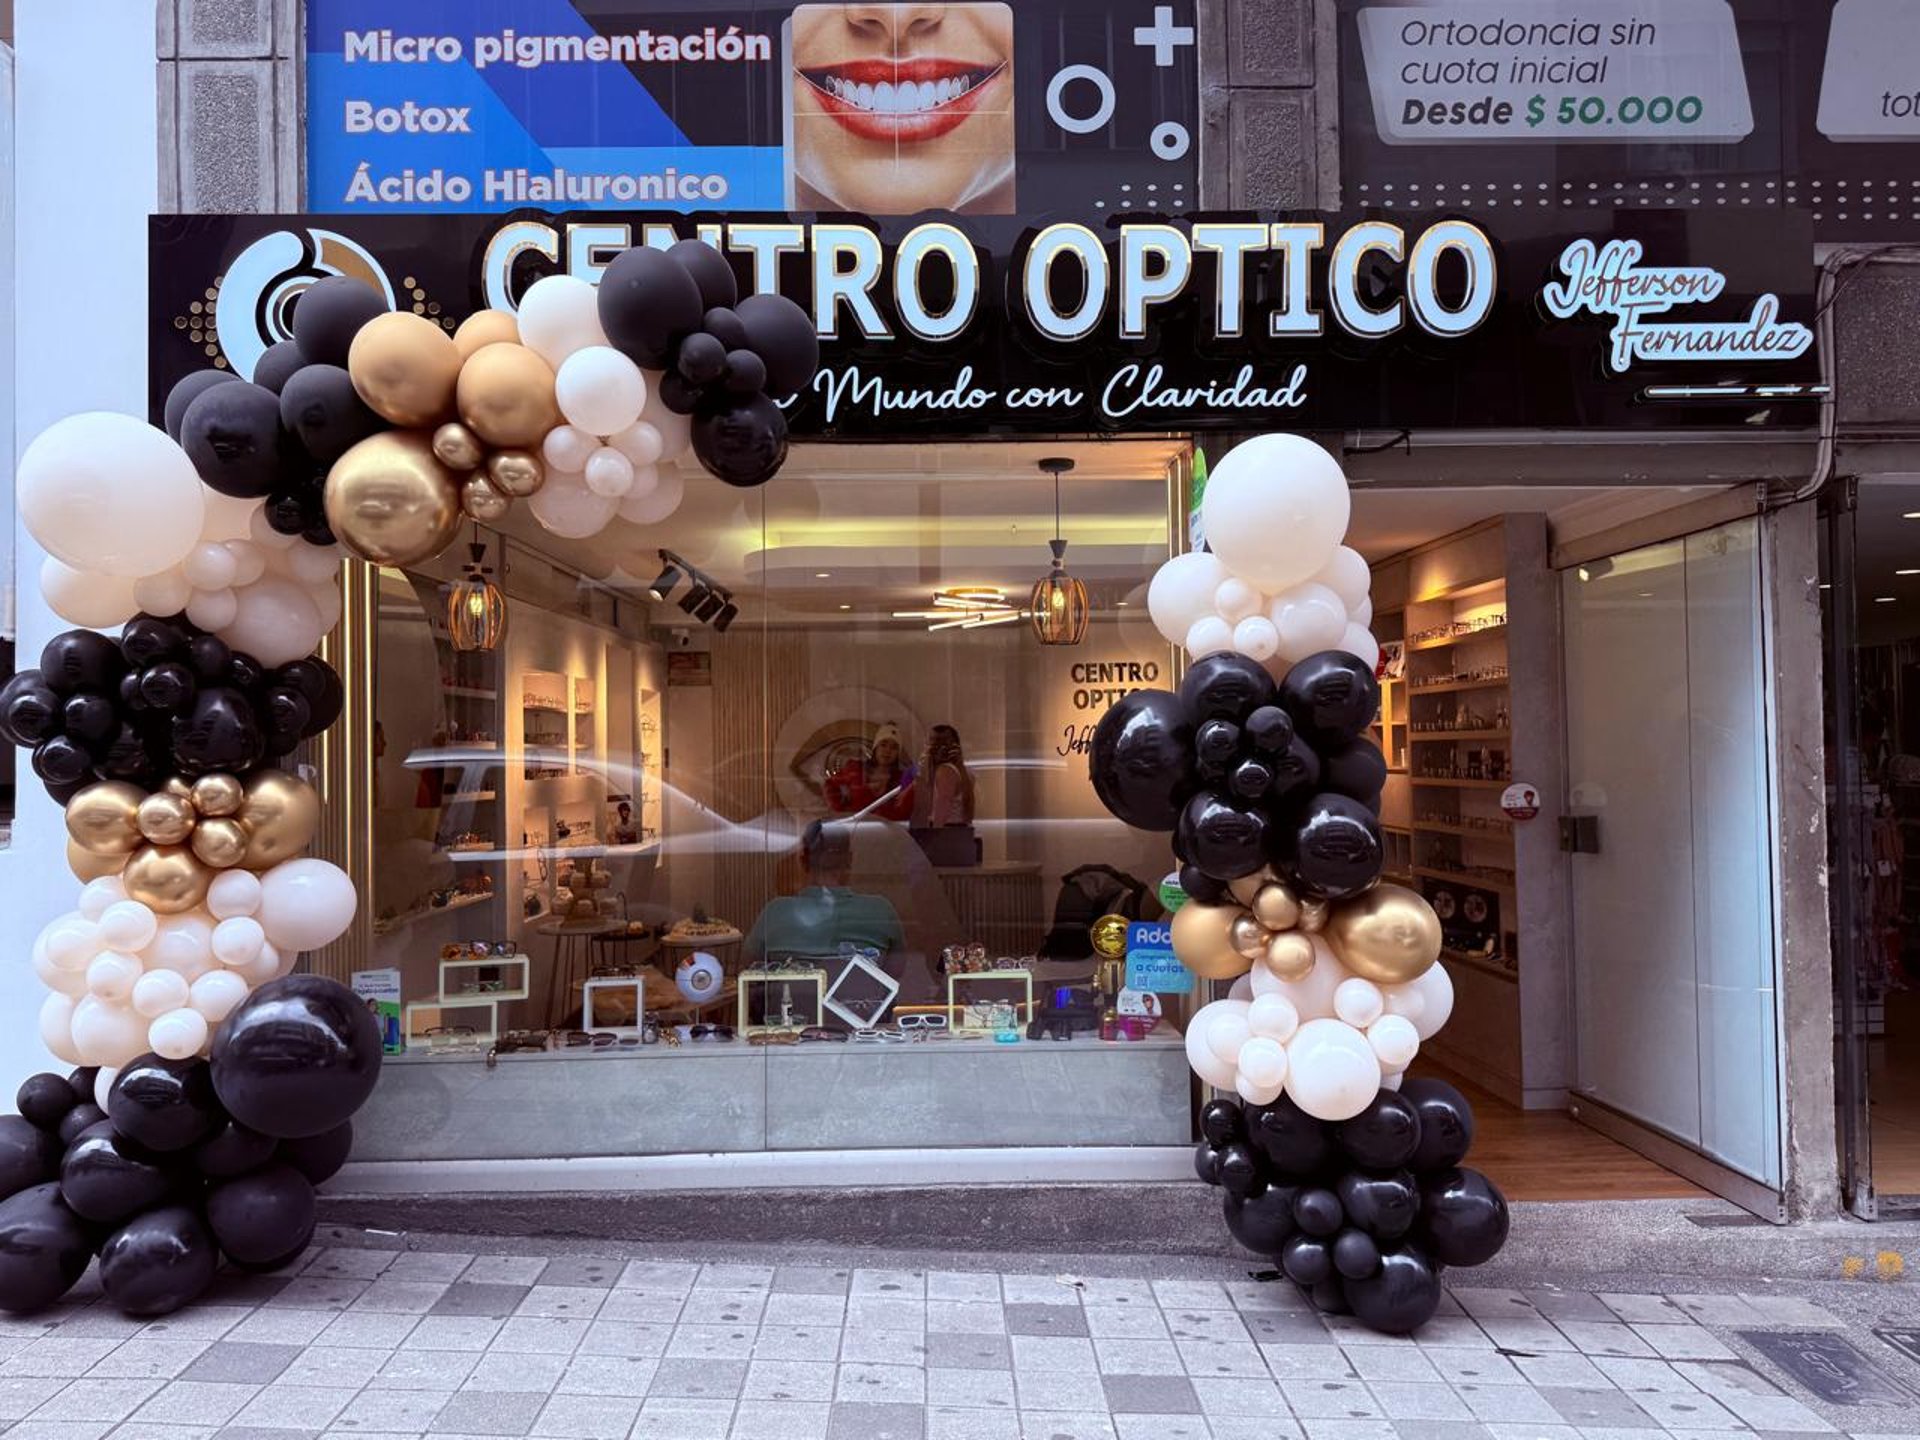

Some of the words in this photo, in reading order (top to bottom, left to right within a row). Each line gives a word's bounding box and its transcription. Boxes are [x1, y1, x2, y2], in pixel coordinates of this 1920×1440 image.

[344, 30, 462, 62] Micro
[474, 26, 771, 69] pigmentación
[1401, 20, 1600, 46] Ortodoncia
[1609, 20, 1656, 46] sin
[1401, 57, 1500, 84] cuota
[1509, 56, 1608, 84] inicial
[345, 101, 471, 134] Botox
[1401, 97, 1514, 126] Desde
[1525, 94, 1546, 128] $
[1556, 96, 1704, 125] 50.000
[345, 162, 472, 202] Ácido
[483, 167, 728, 202] Hialuronico
[482, 221, 980, 342] CETRO
[1023, 220, 1498, 342] OPTICO
[1547, 241, 1723, 314] Jefferson
[1613, 295, 1809, 368] Fernandez
[813, 365, 997, 423] Mundo
[1004, 386, 1083, 408] con
[1101, 364, 1308, 417] Claridad
[1071, 662, 1159, 683] CENTRO
